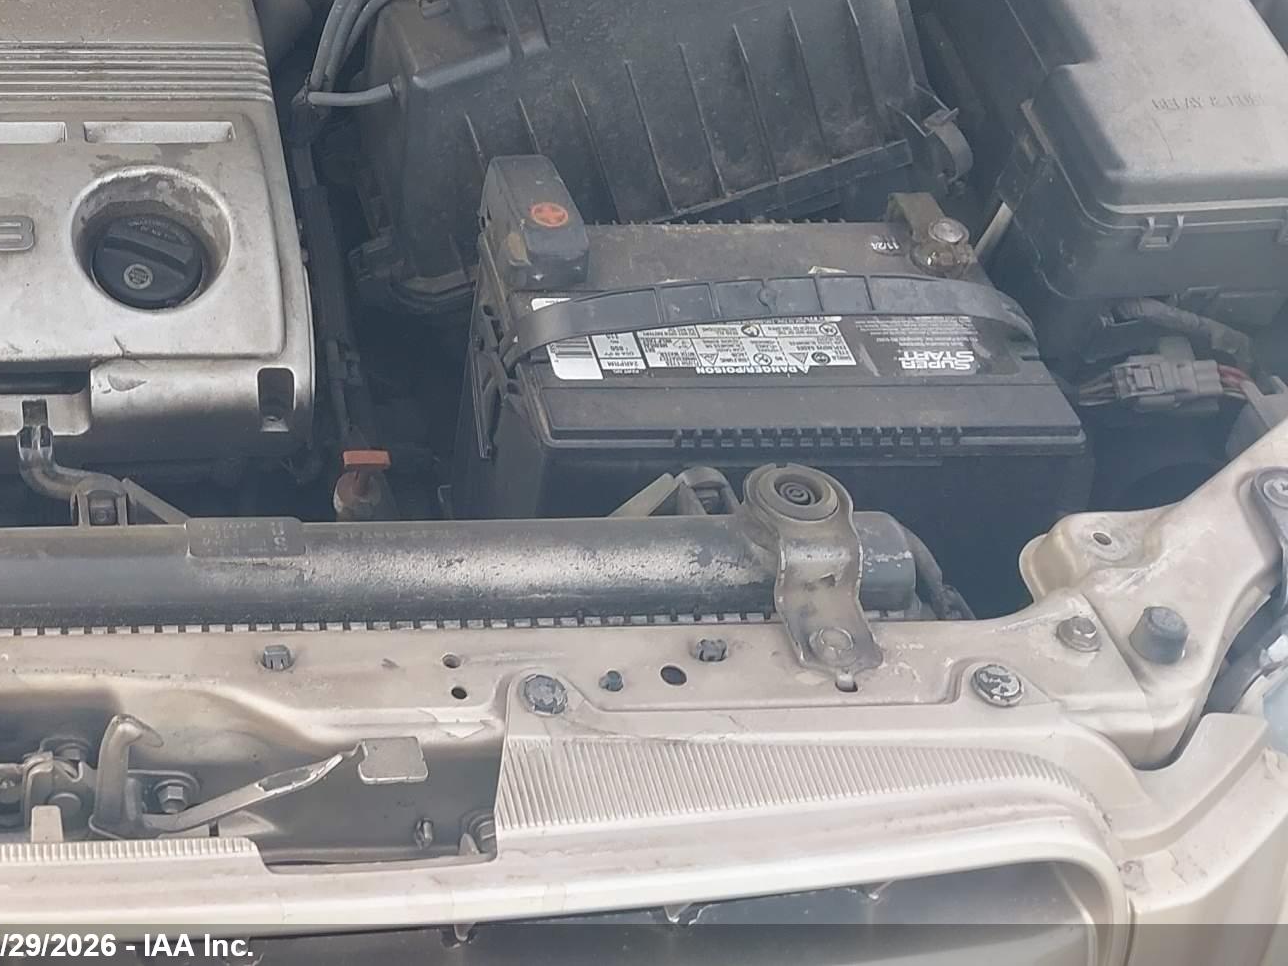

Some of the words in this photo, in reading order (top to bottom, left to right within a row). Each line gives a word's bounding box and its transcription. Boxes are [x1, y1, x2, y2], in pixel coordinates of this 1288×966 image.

[898, 350, 975, 363] START
[696, 364, 798, 375] DANGER/POISON
[900, 359, 971, 370] SUPER
